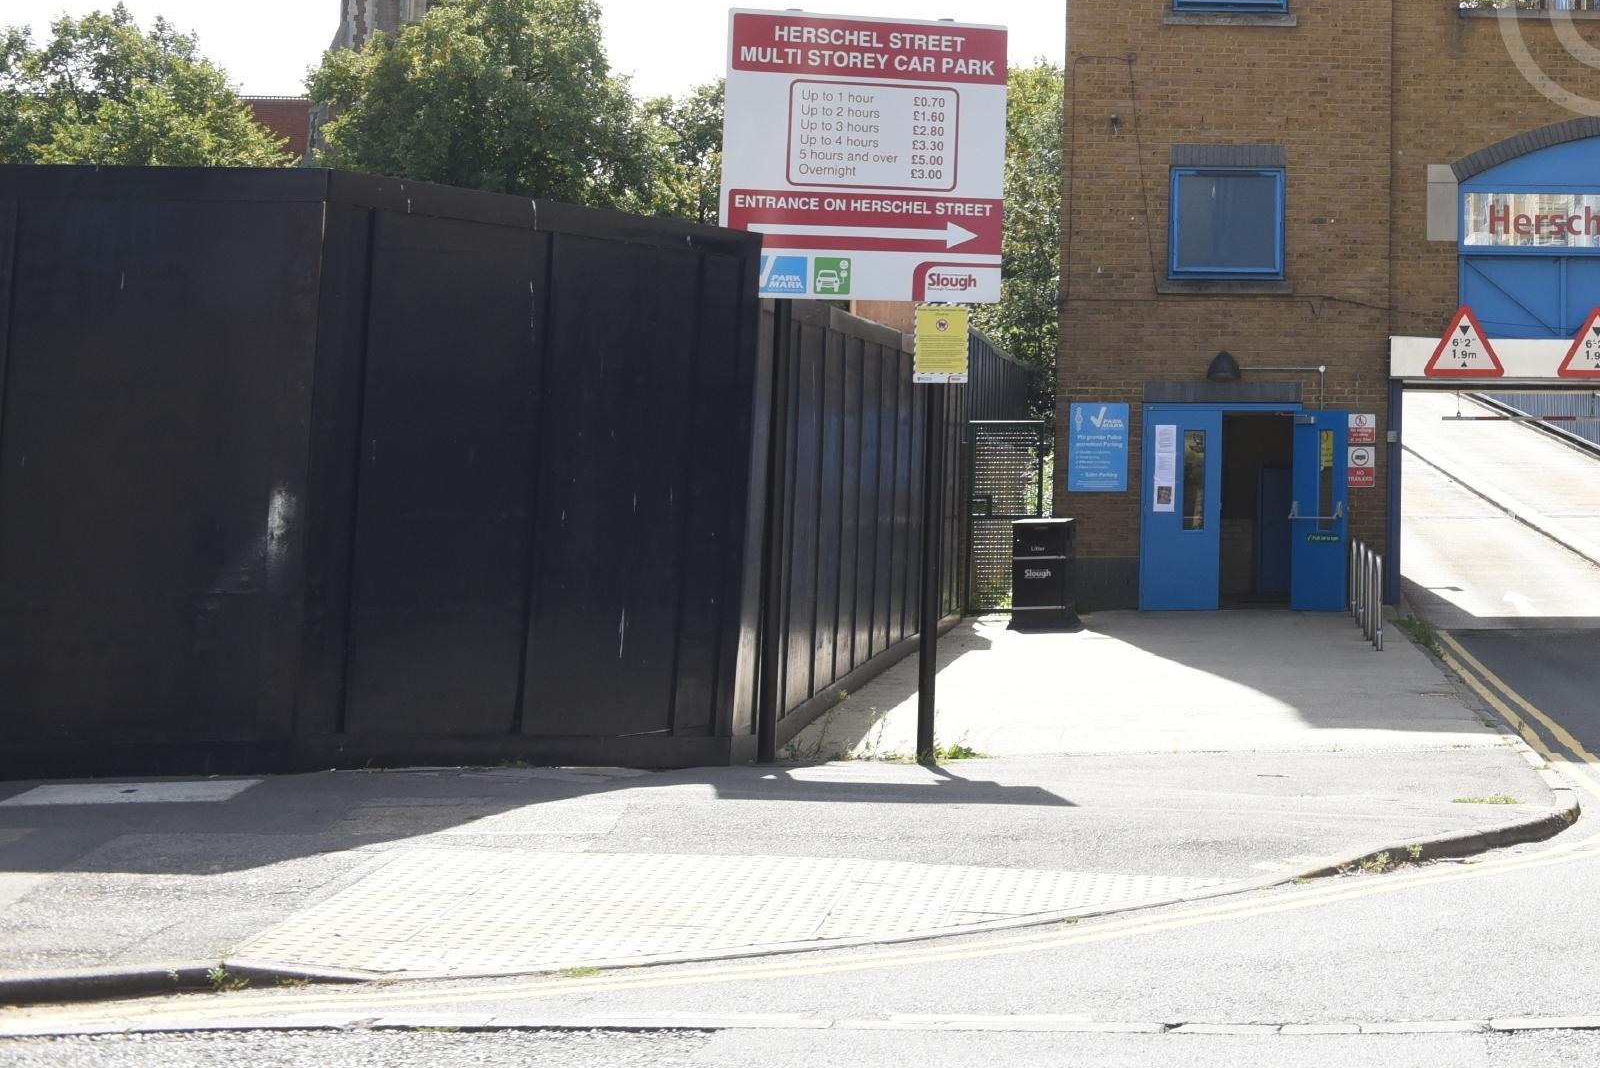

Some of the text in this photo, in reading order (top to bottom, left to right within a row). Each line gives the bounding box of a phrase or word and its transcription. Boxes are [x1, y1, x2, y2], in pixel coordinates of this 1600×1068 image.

[774, 25, 965, 52] HERSCHEL STREET
[740, 45, 995, 76] MULTI STOREY CAR PARK
[802, 89, 945, 108] Up to 1 hour £0.70
[801, 103, 945, 122] Up to 2 hours £1.60
[800, 118, 944, 137] Up to 3 hours £2.80
[800, 133, 944, 151] Up to 4 hours £3.30
[799, 149, 943, 166] 5 hours and over £5.00
[798, 163, 942, 180] Overnight £3.00
[734, 194, 993, 217] ENTRANCE ON HERSCHEL STREET
[768, 281, 804, 289] MARK
[928, 272, 977, 291] Slough
[1452, 349, 1477, 359] 1.9m
[1024, 568, 1051, 579] Slough
